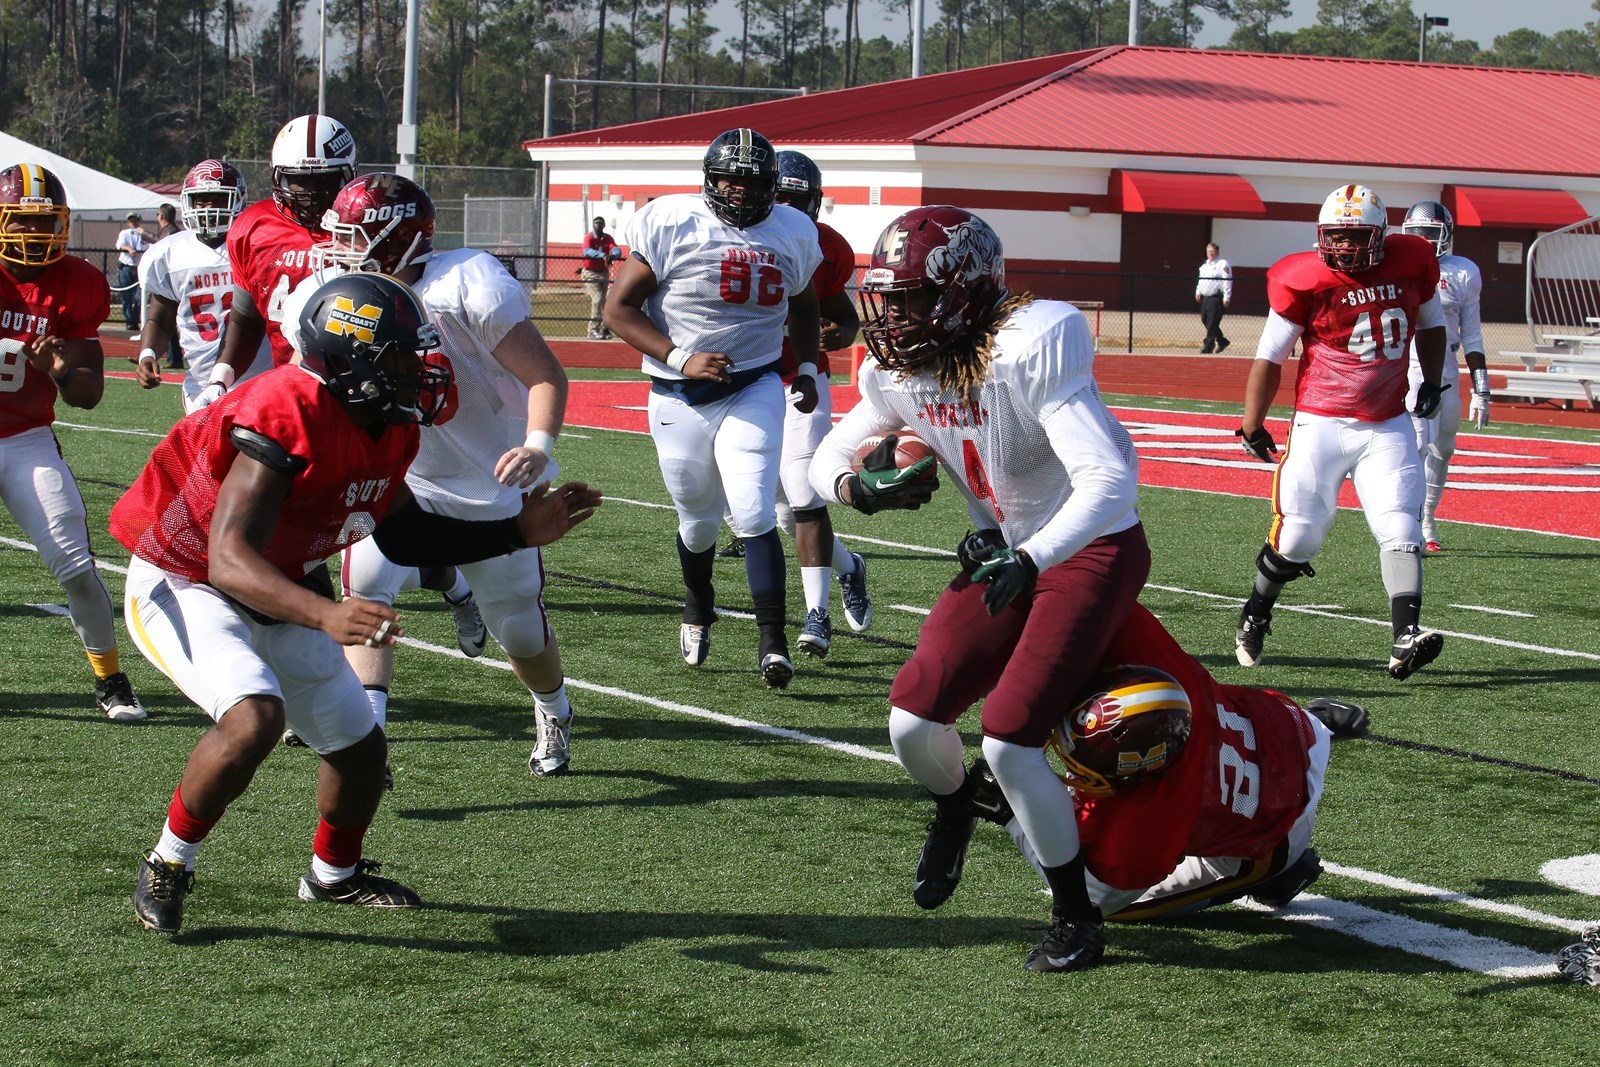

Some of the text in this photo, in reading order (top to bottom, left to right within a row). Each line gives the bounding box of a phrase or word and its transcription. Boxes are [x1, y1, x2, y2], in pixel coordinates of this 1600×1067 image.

[361, 202, 416, 224] DOGS
[873, 222, 910, 265] NE
[728, 249, 775, 265] NORTH
[1347, 284, 1396, 306] SOUTH
[0, 310, 48, 336] OUTH
[331, 310, 375, 328] GULF COAST
[1348, 308, 1408, 362] 40
